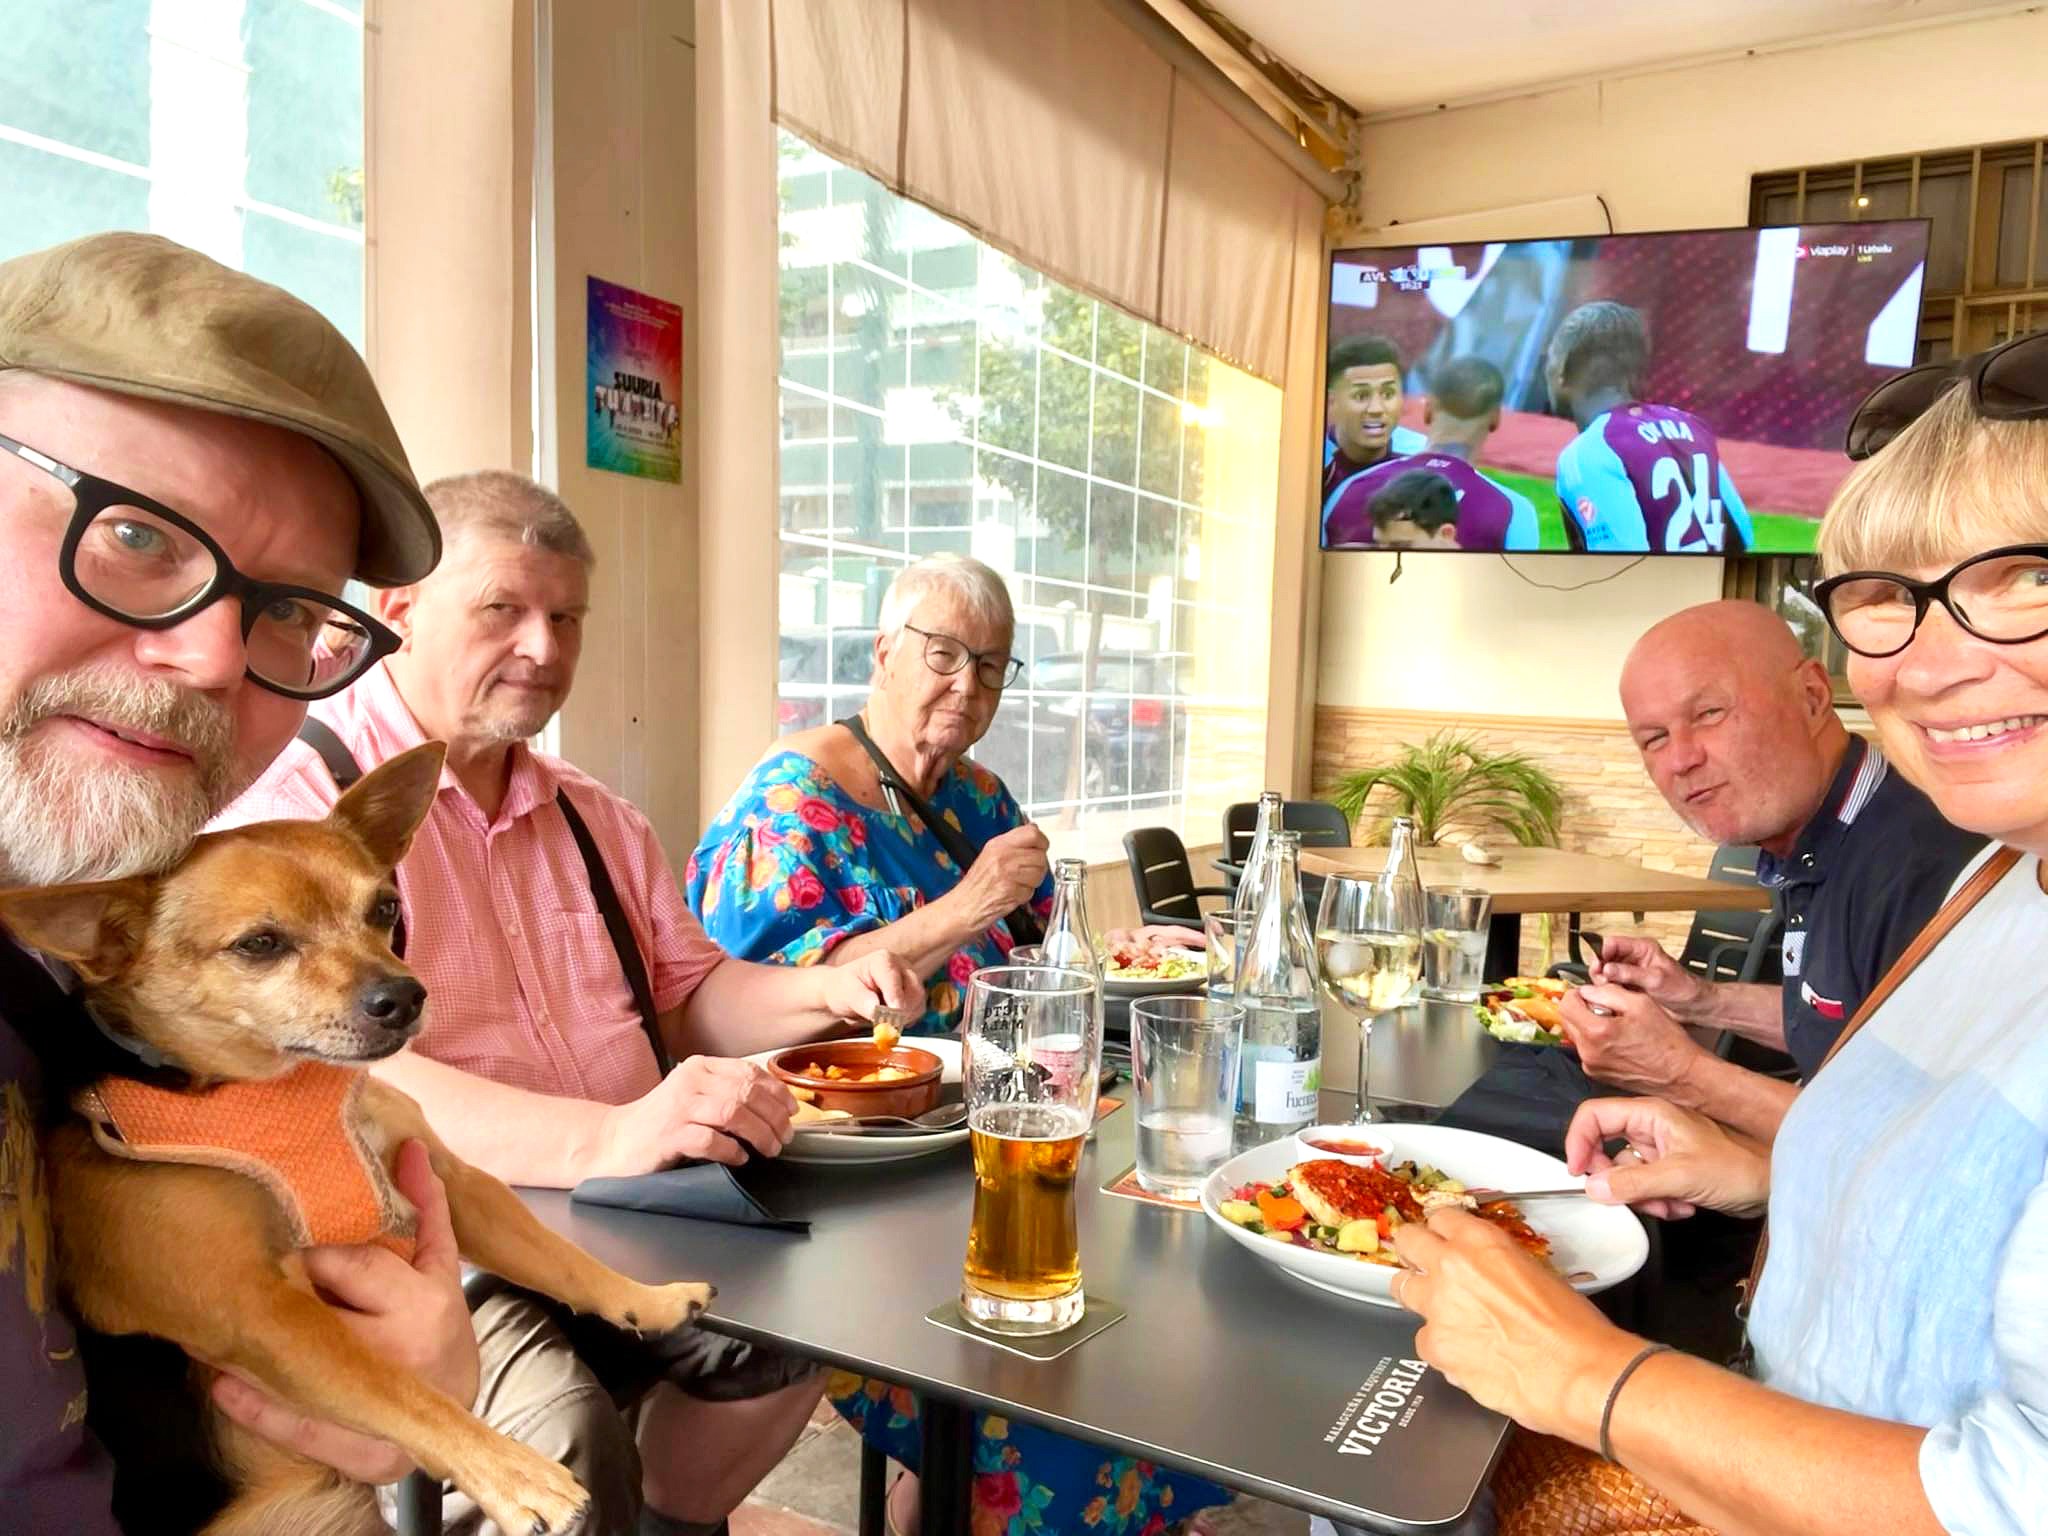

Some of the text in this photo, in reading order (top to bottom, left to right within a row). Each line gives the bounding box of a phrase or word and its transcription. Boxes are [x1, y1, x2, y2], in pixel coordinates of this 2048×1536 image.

[1809, 244, 1849, 256] viaplay
[613, 371, 663, 401] SUURIA
[1652, 452, 1726, 552] 24
[1337, 1359, 1429, 1456] VICTORIA
